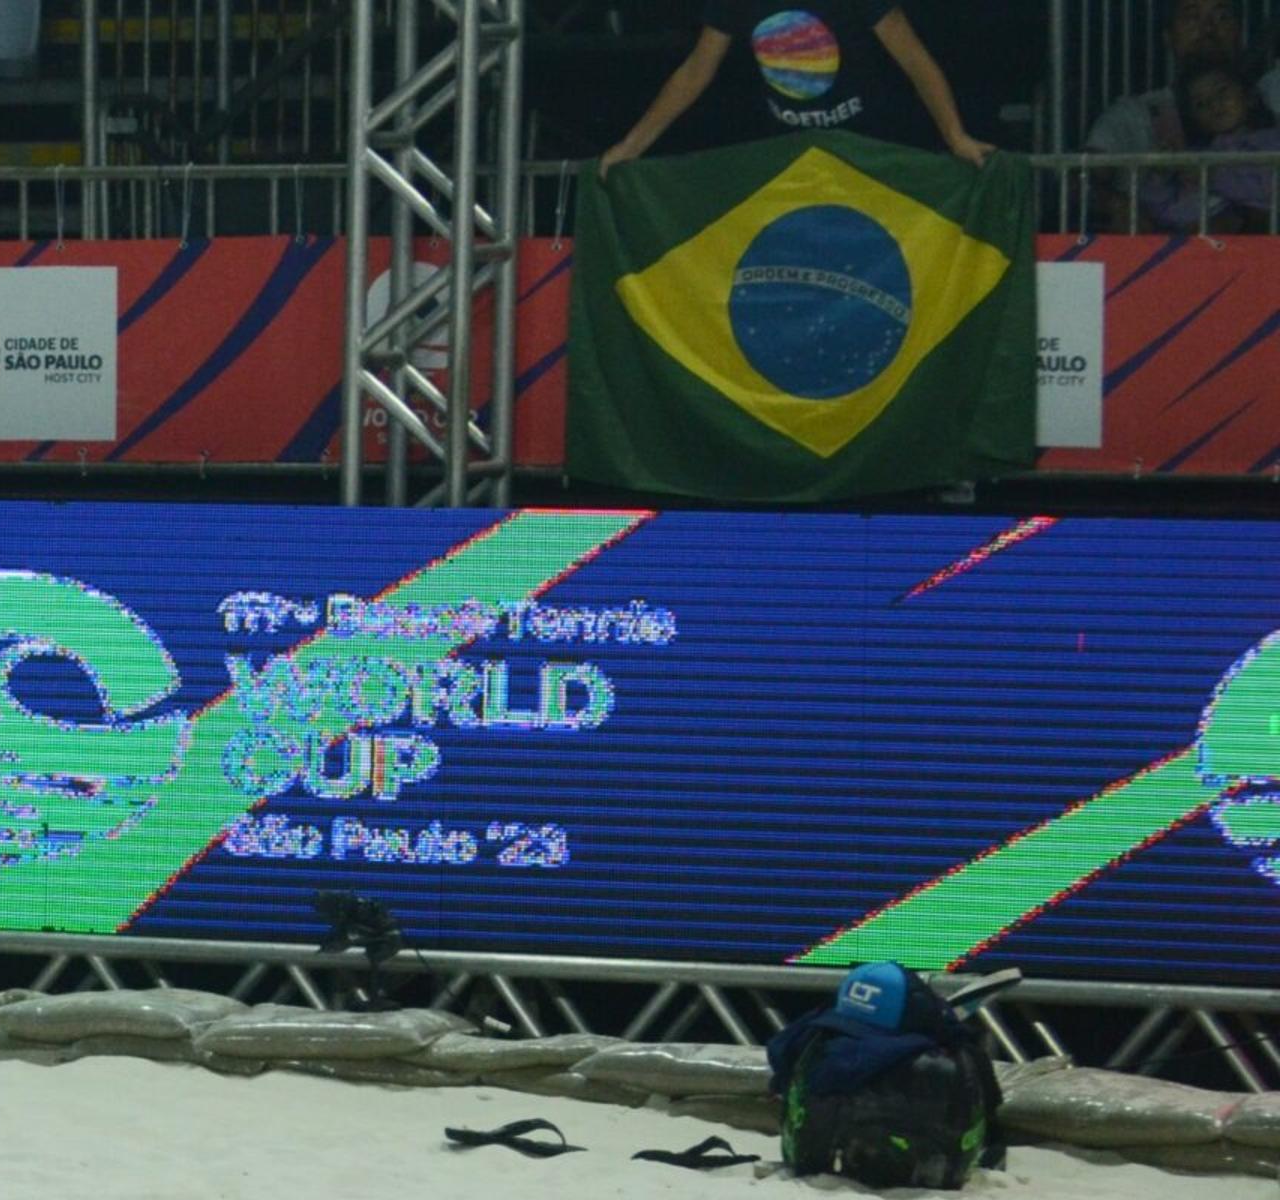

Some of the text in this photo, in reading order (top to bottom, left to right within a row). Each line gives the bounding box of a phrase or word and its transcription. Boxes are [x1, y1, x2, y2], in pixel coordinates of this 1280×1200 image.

[4, 337, 79, 351] CIDADE DE
[1039, 337, 1061, 351] DE
[4, 352, 104, 371] SÃO PAULO
[1035, 355, 1087, 372] AULO
[43, 372, 103, 384] HOST CITY
[1056, 375, 1086, 387] CITY
[506, 600, 678, 645] Tennis
[225, 653, 616, 730] WORLD
[221, 725, 441, 801] CUP
[330, 815, 478, 864] Paulo
